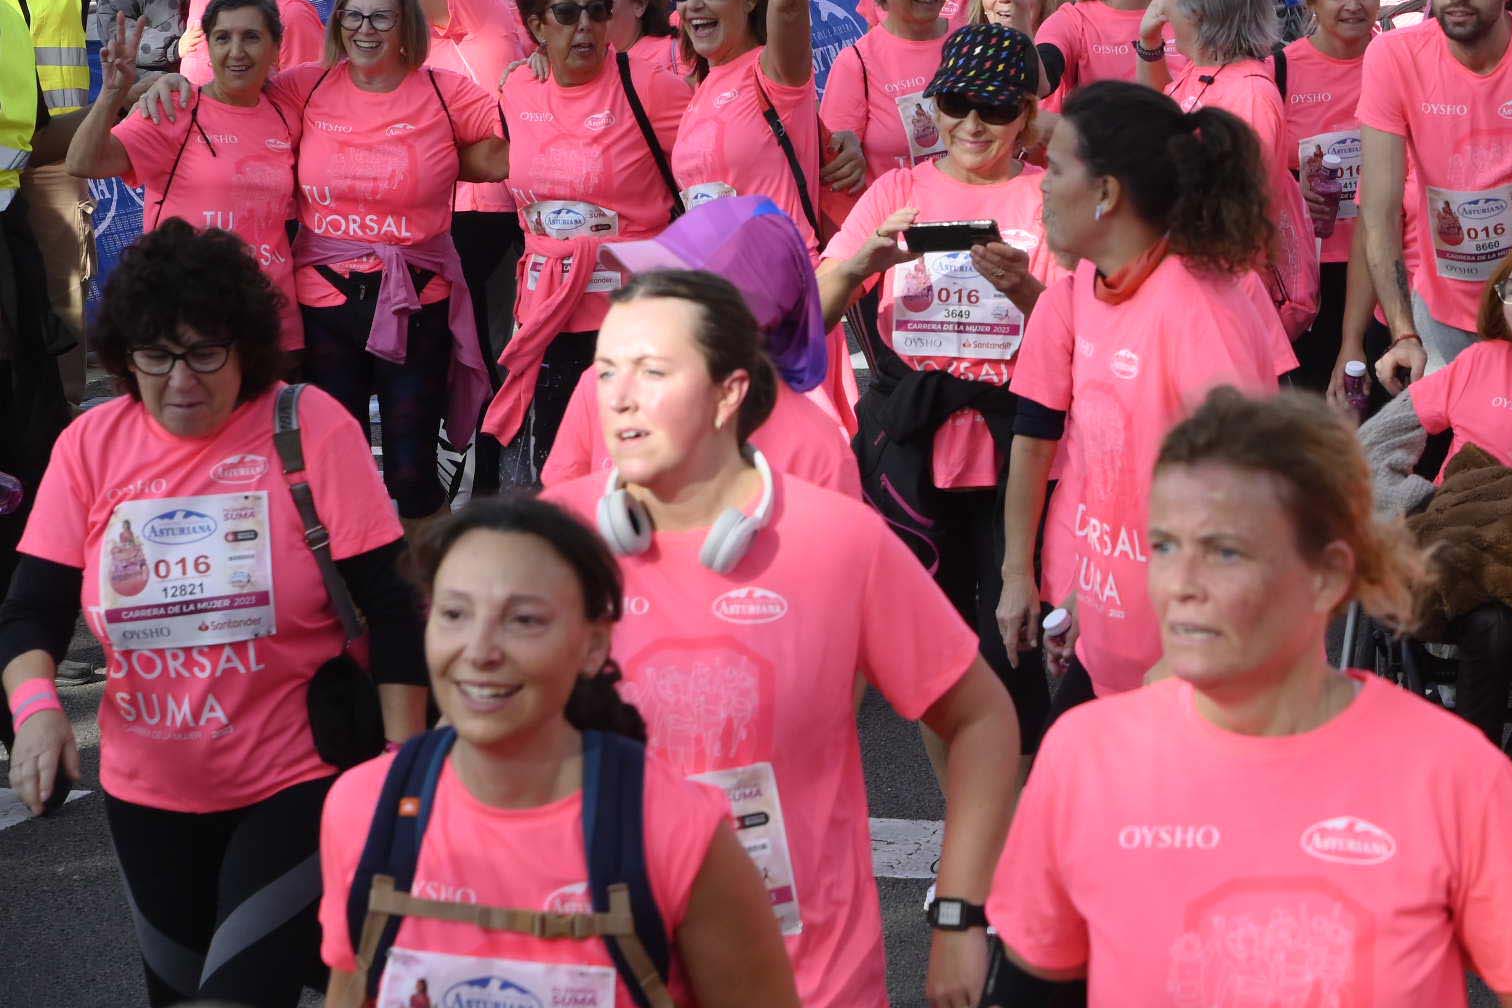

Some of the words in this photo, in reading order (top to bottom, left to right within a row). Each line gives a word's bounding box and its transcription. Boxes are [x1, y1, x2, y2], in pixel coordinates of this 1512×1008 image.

[314, 214, 412, 237] DORSAL
[1466, 223, 1505, 240] 016
[1475, 240, 1500, 251] 8660
[937, 287, 980, 304] 016
[943, 308, 971, 319] 3649
[149, 522, 212, 538] ASTURIANA
[153, 554, 212, 580] 016
[160, 581, 205, 600] 12821
[120, 607, 166, 619] CARRERA
[167, 605, 181, 615] DE
[182, 602, 198, 613] LA
[198, 597, 230, 611] MUJER
[210, 616, 262, 631] Santander
[115, 691, 229, 728] SUMA
[1118, 824, 1221, 849] OYSHO
